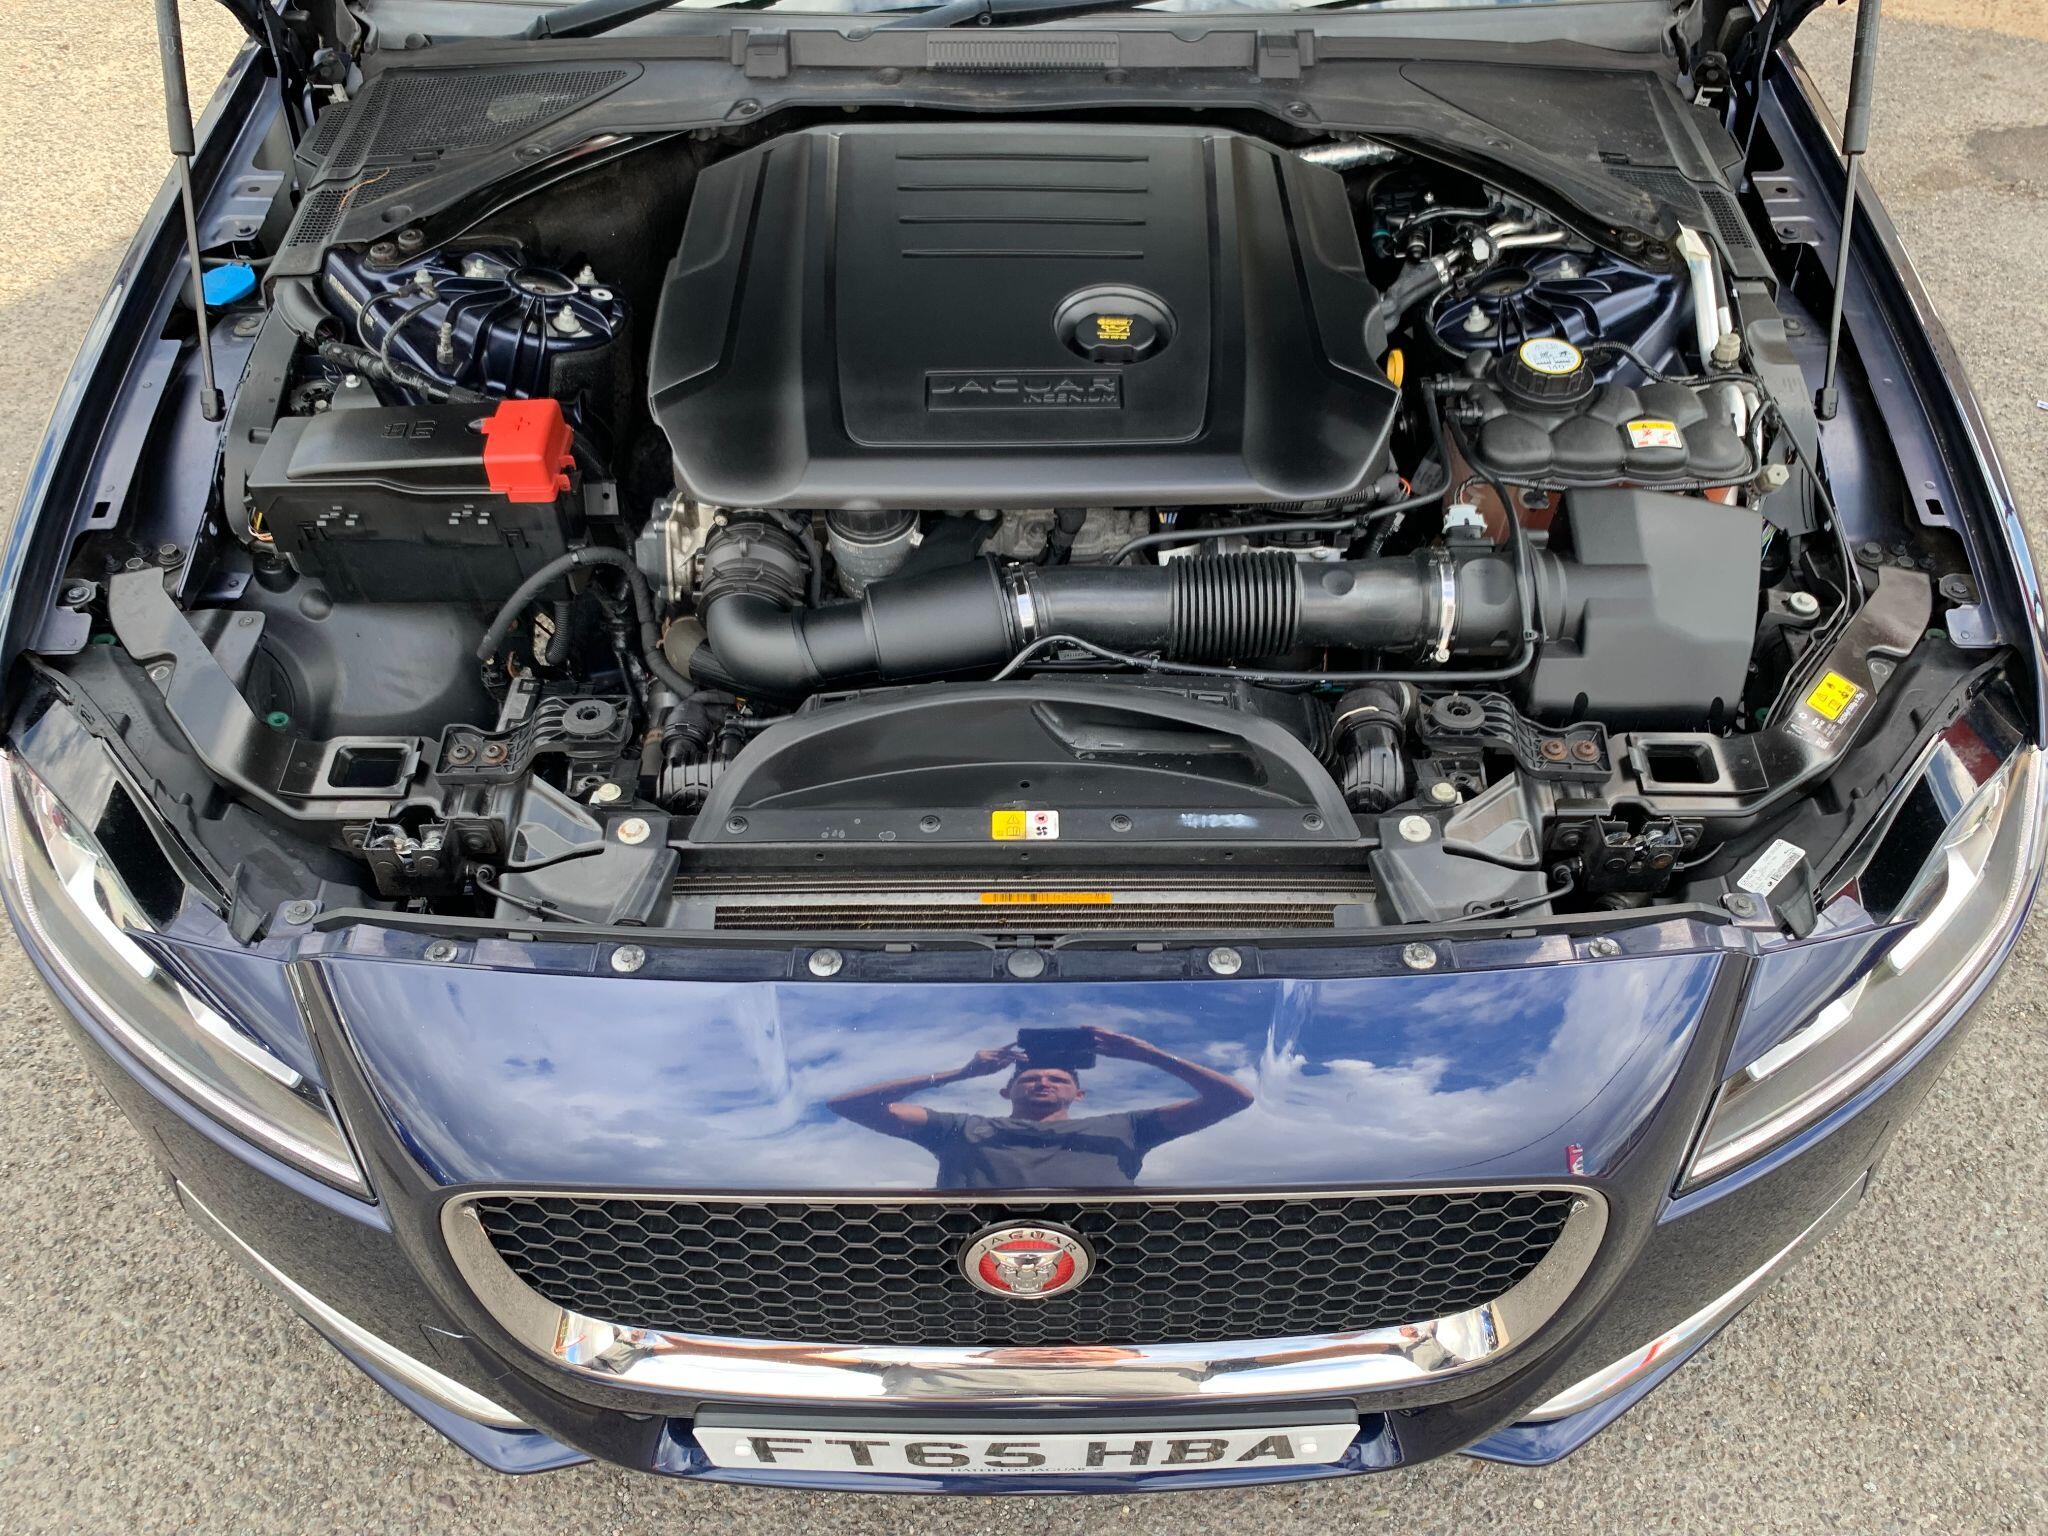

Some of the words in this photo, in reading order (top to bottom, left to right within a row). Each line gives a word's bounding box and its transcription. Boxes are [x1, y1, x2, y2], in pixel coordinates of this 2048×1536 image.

[931, 377, 1116, 394] JAGUAR
[1023, 394, 1117, 404] INGENIUM
[980, 1230, 1077, 1253] JAGUAR
[746, 1436, 1047, 1468] FT65
[1085, 1434, 1295, 1467] HBA
